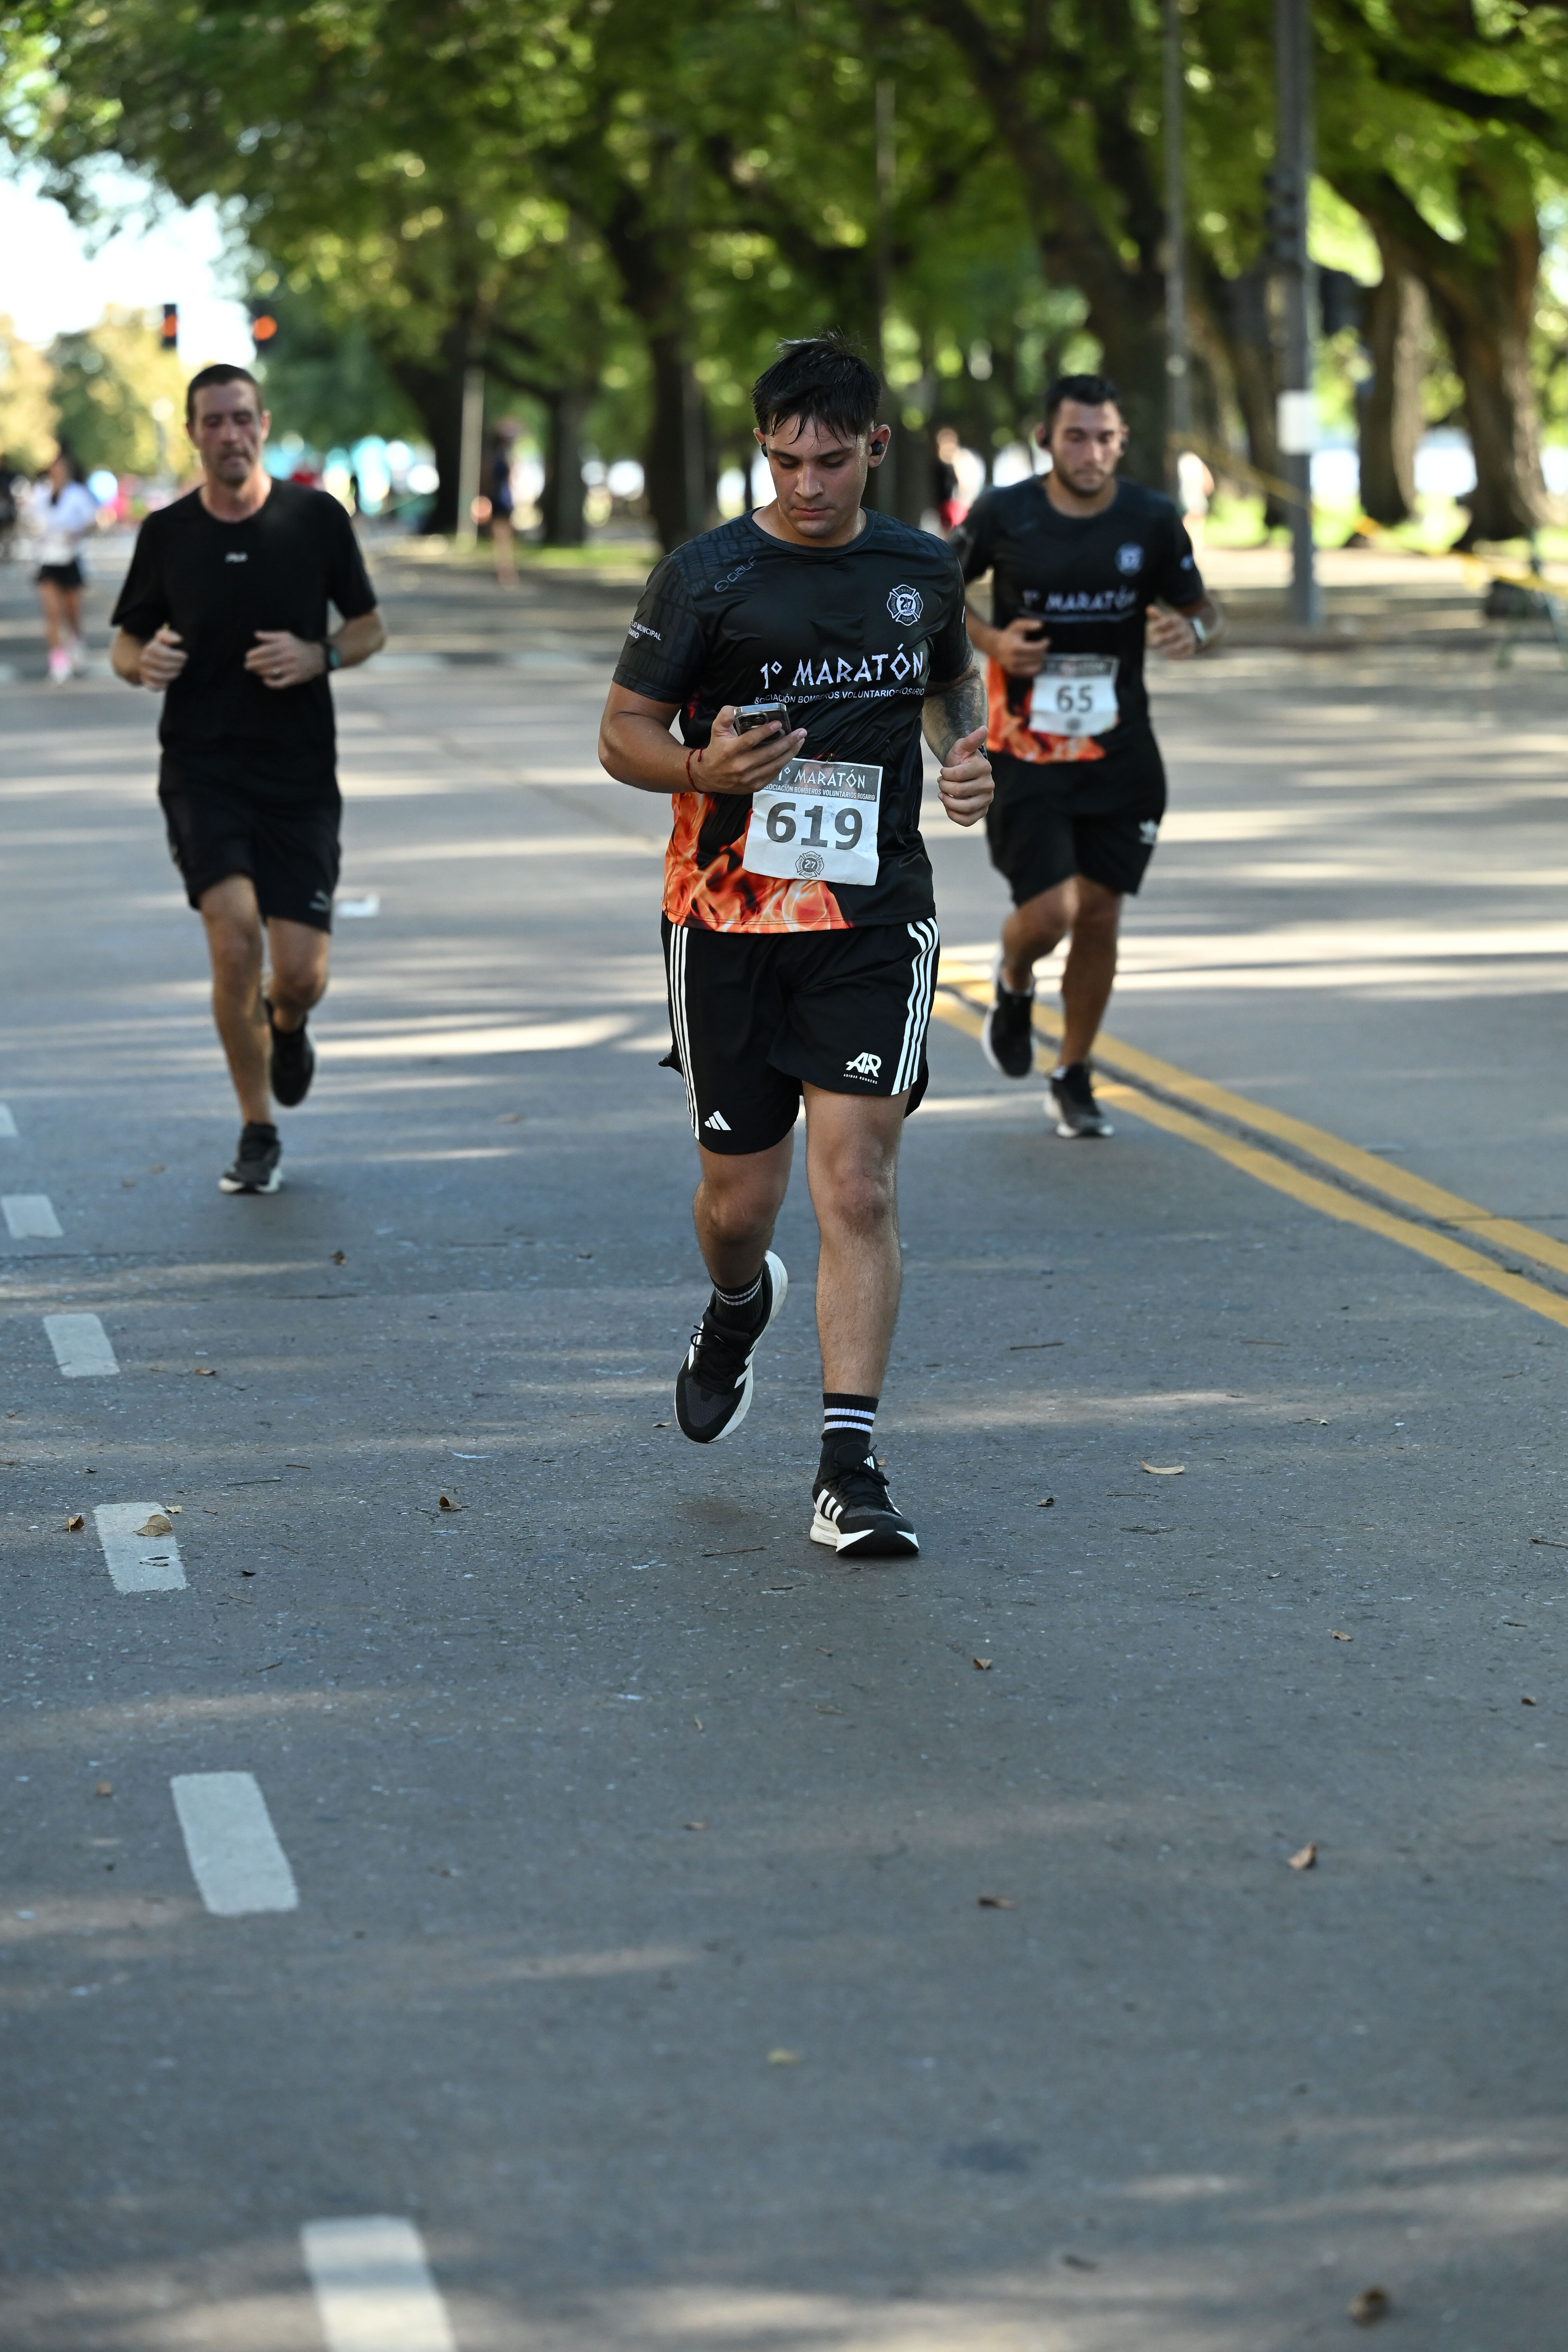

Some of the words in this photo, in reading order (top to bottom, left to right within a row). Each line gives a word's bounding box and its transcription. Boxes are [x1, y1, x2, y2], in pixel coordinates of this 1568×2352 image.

[900, 597, 913, 610] 27
[792, 643, 923, 686] MARATÓN
[798, 691, 840, 703] BOMBEROS
[1057, 685, 1093, 712] 65
[794, 769, 865, 789] MARATÓN
[764, 783, 793, 792] SOCIACIÓN
[794, 786, 821, 795] BOMBEROS
[822, 789, 856, 798] VOLUNTARIOS
[857, 793, 875, 801] ROSARIO
[766, 802, 863, 850] 619
[804, 859, 816, 868] 27
[859, 1076, 878, 1084] RUNNERS
